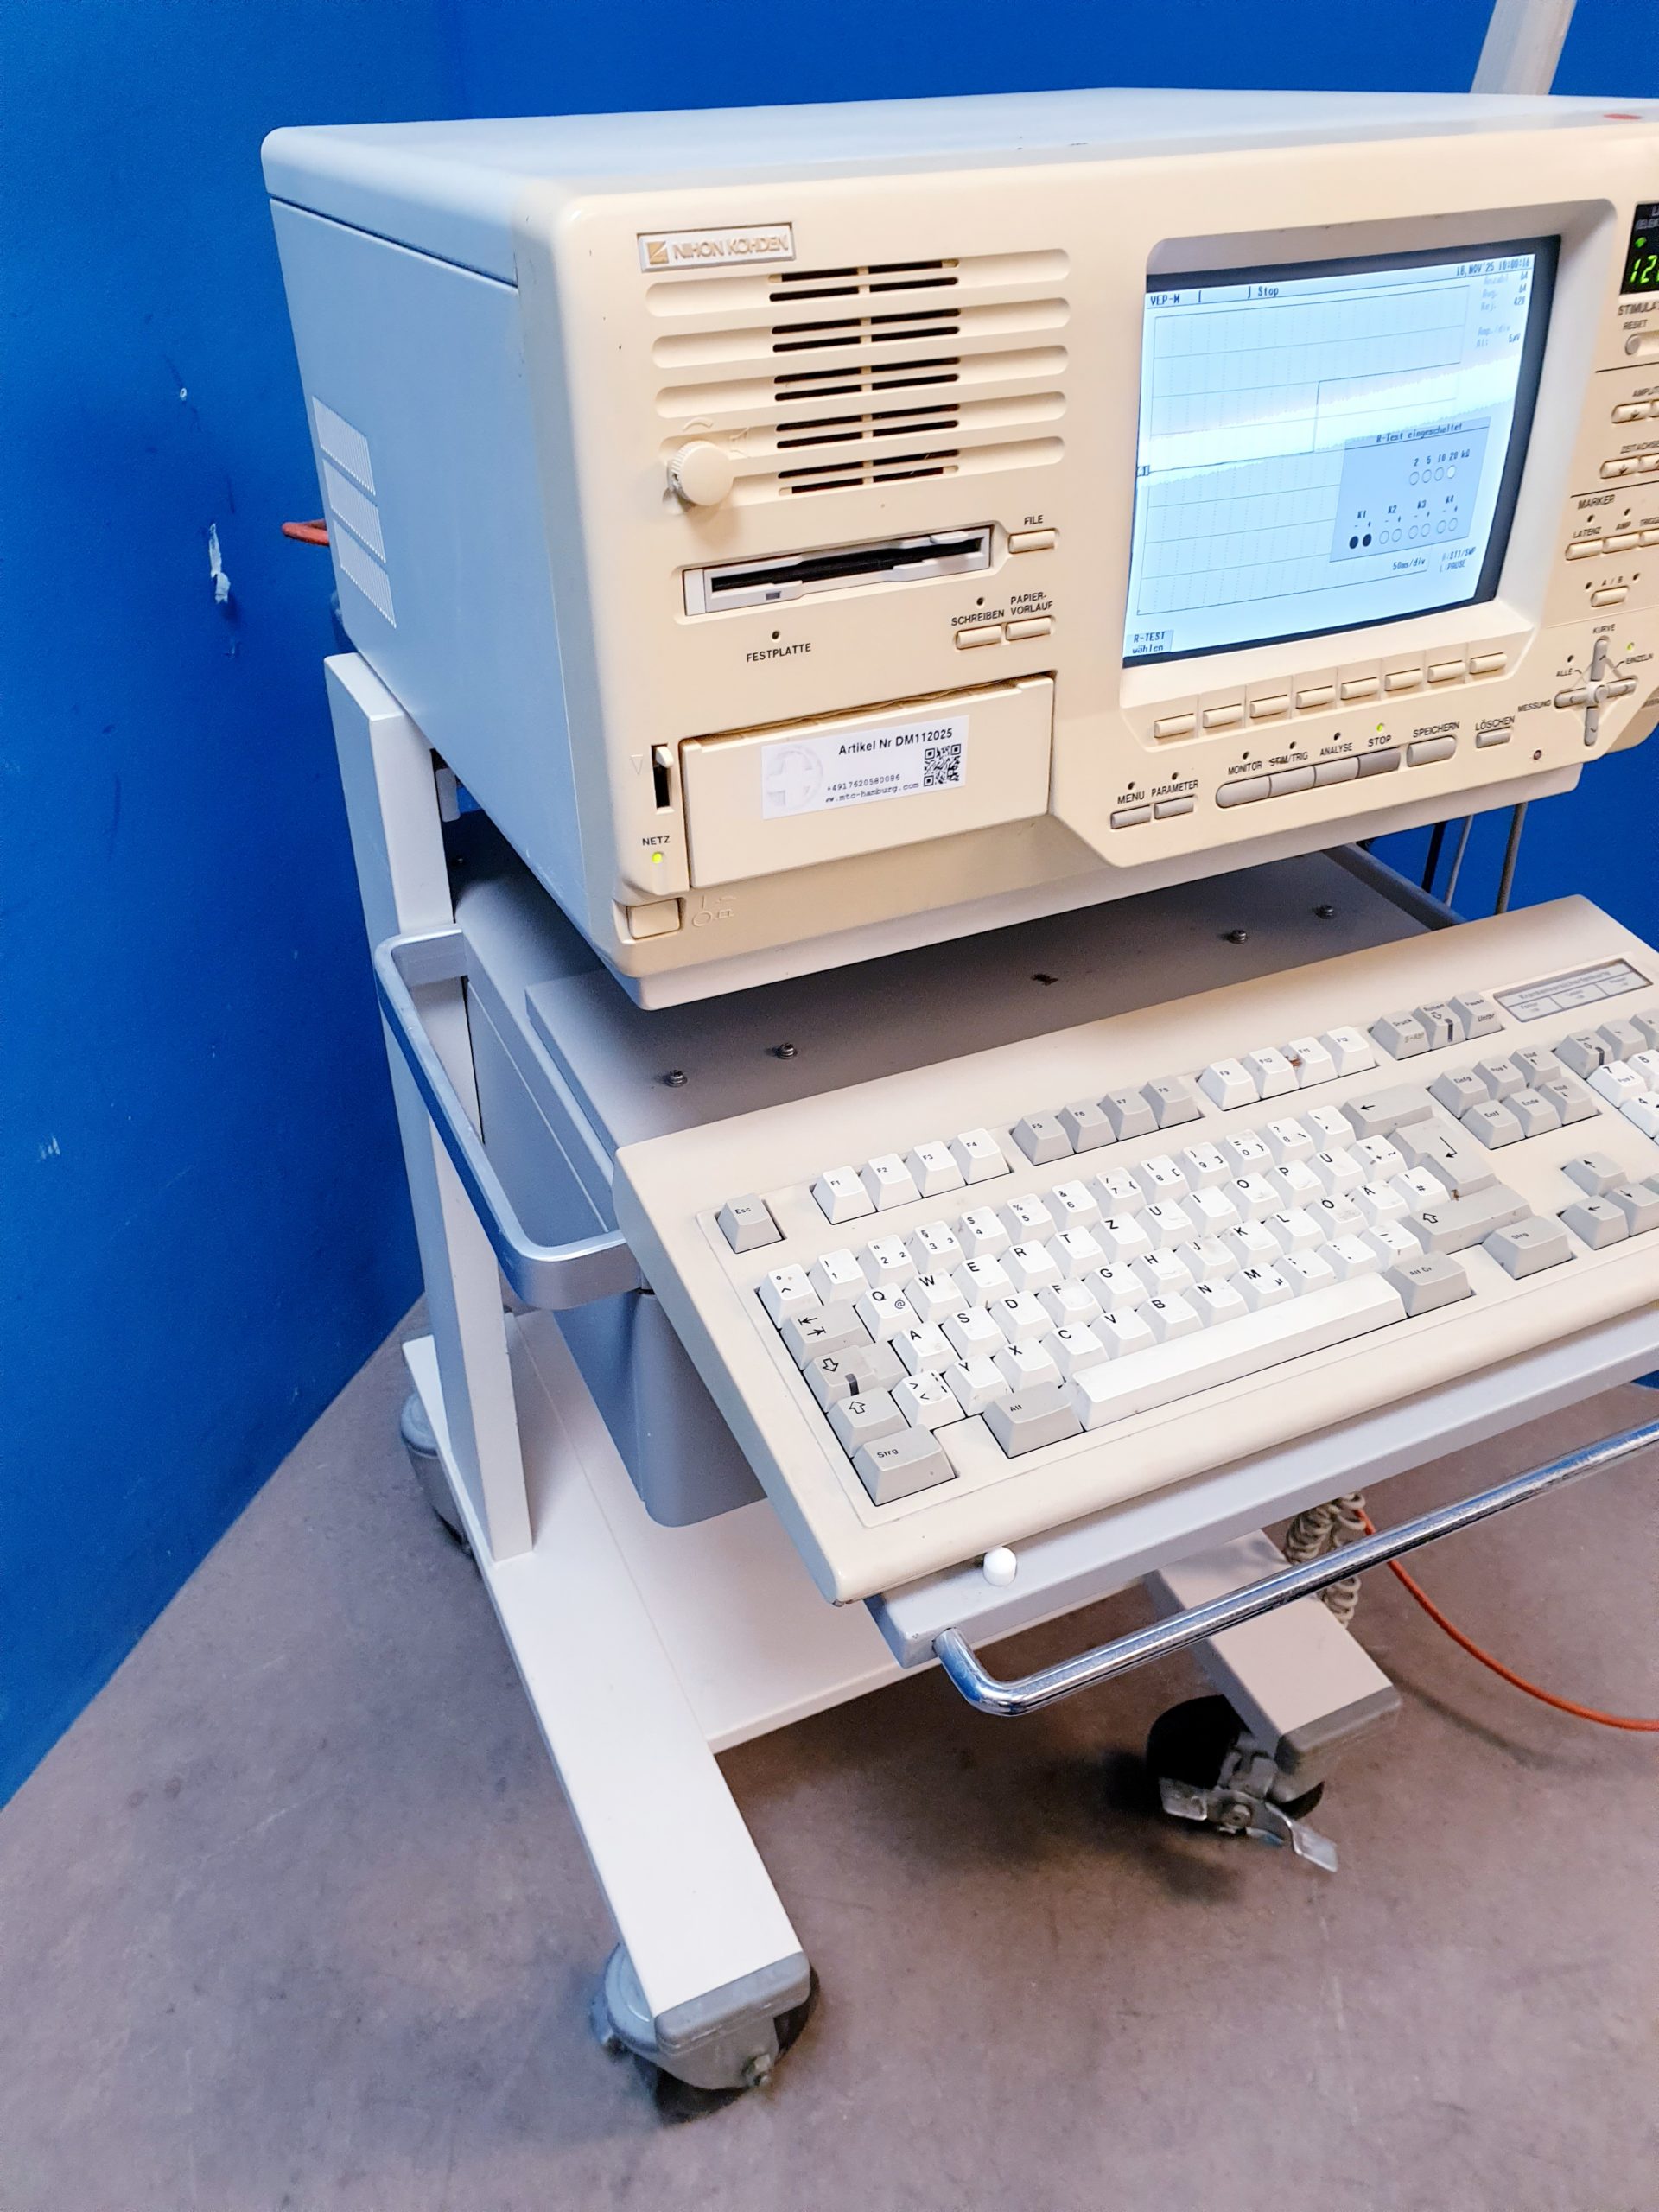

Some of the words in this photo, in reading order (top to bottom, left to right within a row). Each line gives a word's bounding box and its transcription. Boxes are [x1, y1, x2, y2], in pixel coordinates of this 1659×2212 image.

[674, 239, 724, 259] NIHON
[728, 235, 789, 256] KOHDEN
[1258, 286, 1280, 297] Stop
[1150, 293, 1180, 306] VEP-M
[1618, 301, 1659, 316] STIMULA
[1408, 423, 1463, 439] eingeschaltet
[1578, 494, 1616, 510] MARKER
[1024, 515, 1044, 525] FILE
[1573, 526, 1602, 538] LATENZ
[1010, 592, 1047, 605] PAPIER-
[1010, 601, 1053, 615] VORLAUF
[951, 609, 1005, 626] SCHREIBEN
[1592, 623, 1616, 634] KURVE
[1134, 631, 1166, 643] R-TEST
[746, 643, 812, 663] FESTPLATTE
[1556, 668, 1573, 677] ALLE
[1517, 699, 1552, 713] MESSUNG
[1475, 715, 1516, 731] LÖSCHEN
[1413, 721, 1460, 739] SPEICHERN
[838, 741, 876, 755] Artikel
[879, 738, 893, 749] Nr
[895, 728, 953, 747] DM112025
[1368, 734, 1392, 747] STOP
[1319, 742, 1353, 757] ANALYSE
[1268, 751, 1309, 767] STIM/TRIG
[1228, 760, 1262, 776] MONITOR
[1151, 779, 1199, 798] PARAMETER
[1117, 790, 1145, 804] MENU
[642, 836, 671, 847] NETZ
[1278, 1166, 1289, 1176] P
[1148, 1205, 1163, 1216] U
[1104, 1219, 1120, 1230] Z
[1276, 1214, 1290, 1224] L
[1234, 1226, 1248, 1236] K
[1059, 1234, 1071, 1243] T
[1192, 1241, 1201, 1251] J
[1014, 1247, 1027, 1257] R
[1144, 1254, 1159, 1265] H
[967, 1262, 980, 1272] E
[1099, 1268, 1113, 1279] G
[1243, 1268, 1261, 1280] M
[918, 1274, 935, 1287] W
[1052, 1284, 1062, 1294] F
[1198, 1284, 1212, 1294] N
[872, 1291, 887, 1302] Q
[1005, 1299, 1019, 1309] D
[1151, 1300, 1166, 1310] B
[957, 1313, 970, 1324] S
[1103, 1313, 1116, 1324] V
[909, 1330, 922, 1340] A
[1058, 1329, 1072, 1339] C
[1007, 1345, 1023, 1356] X
[958, 1362, 970, 1372] Y
[1009, 1402, 1023, 1413] Alt
[876, 1447, 899, 1459] Strg
